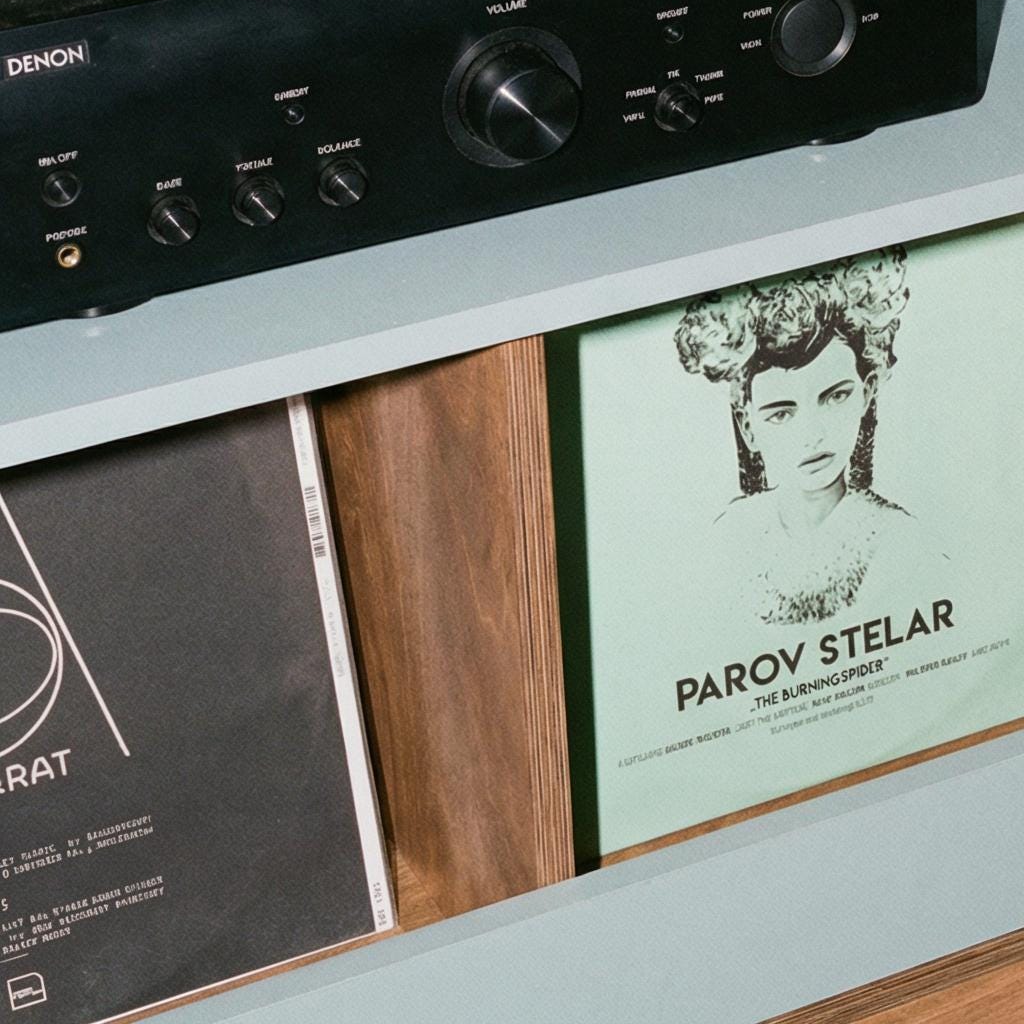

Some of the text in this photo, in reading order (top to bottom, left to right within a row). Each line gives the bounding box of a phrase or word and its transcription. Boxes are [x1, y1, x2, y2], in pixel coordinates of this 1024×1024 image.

[7, 44, 84, 77] DENON
[675, 641, 806, 712] PAROV
[818, 598, 955, 666] STELAR
[0, 748, 71, 794] RAT
